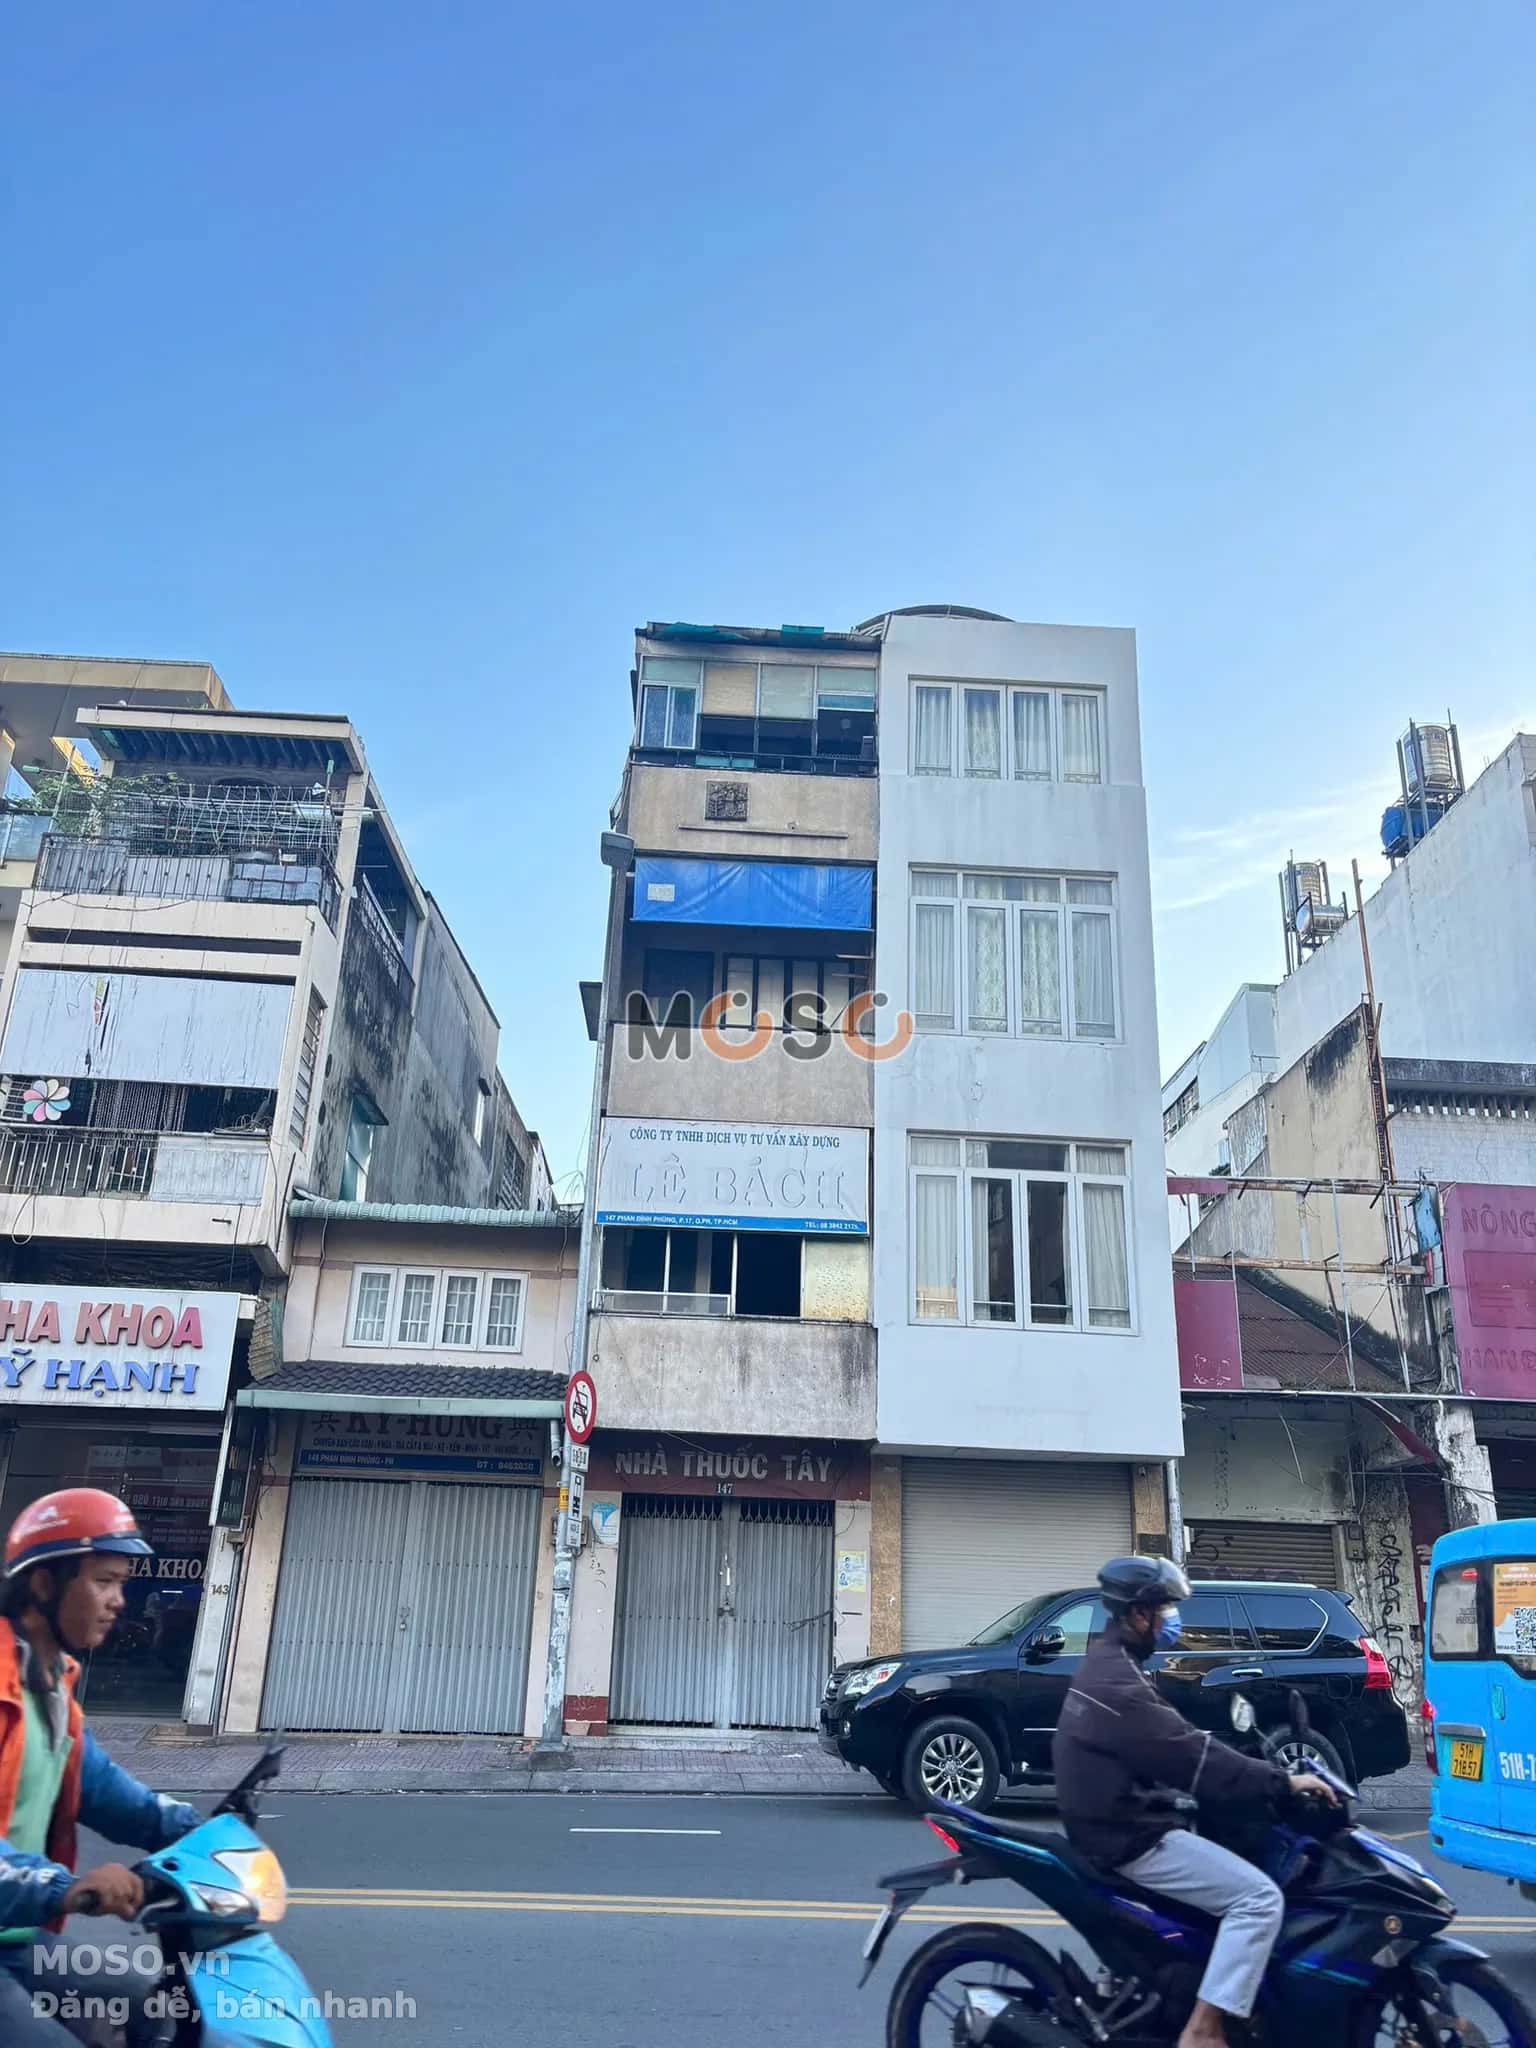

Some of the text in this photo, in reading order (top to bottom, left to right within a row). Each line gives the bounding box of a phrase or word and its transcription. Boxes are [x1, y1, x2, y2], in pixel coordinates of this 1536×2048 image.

[629, 1126, 841, 1150] CÔNG TY TNHH DỊCH VỤ TƯ VẤN XÂY DỰNG
[76, 1302, 203, 1349] KHOA
[44, 1358, 200, 1398] HẠNH
[615, 1443, 668, 1476] NHÀ
[680, 1442, 769, 1480] THUỐC
[782, 1449, 832, 1482] TÂY
[716, 1482, 734, 1495] 147
[211, 1583, 229, 1596] 143
[1459, 1743, 1474, 1759] 51H
